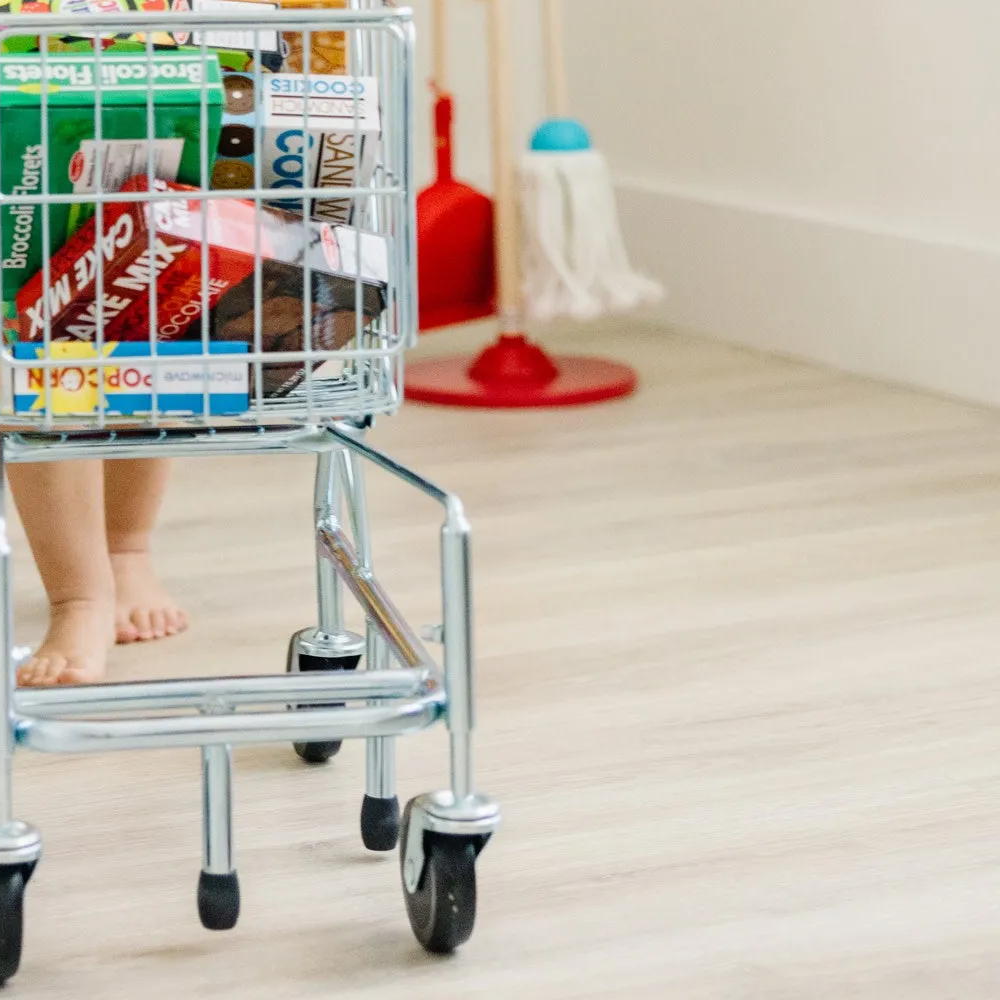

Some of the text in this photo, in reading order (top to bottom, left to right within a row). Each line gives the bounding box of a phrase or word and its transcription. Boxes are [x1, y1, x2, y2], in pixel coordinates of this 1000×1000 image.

[76, 212, 134, 292] CAKE
[113, 236, 188, 292] MIX
[27, 365, 152, 393] POPCORN
